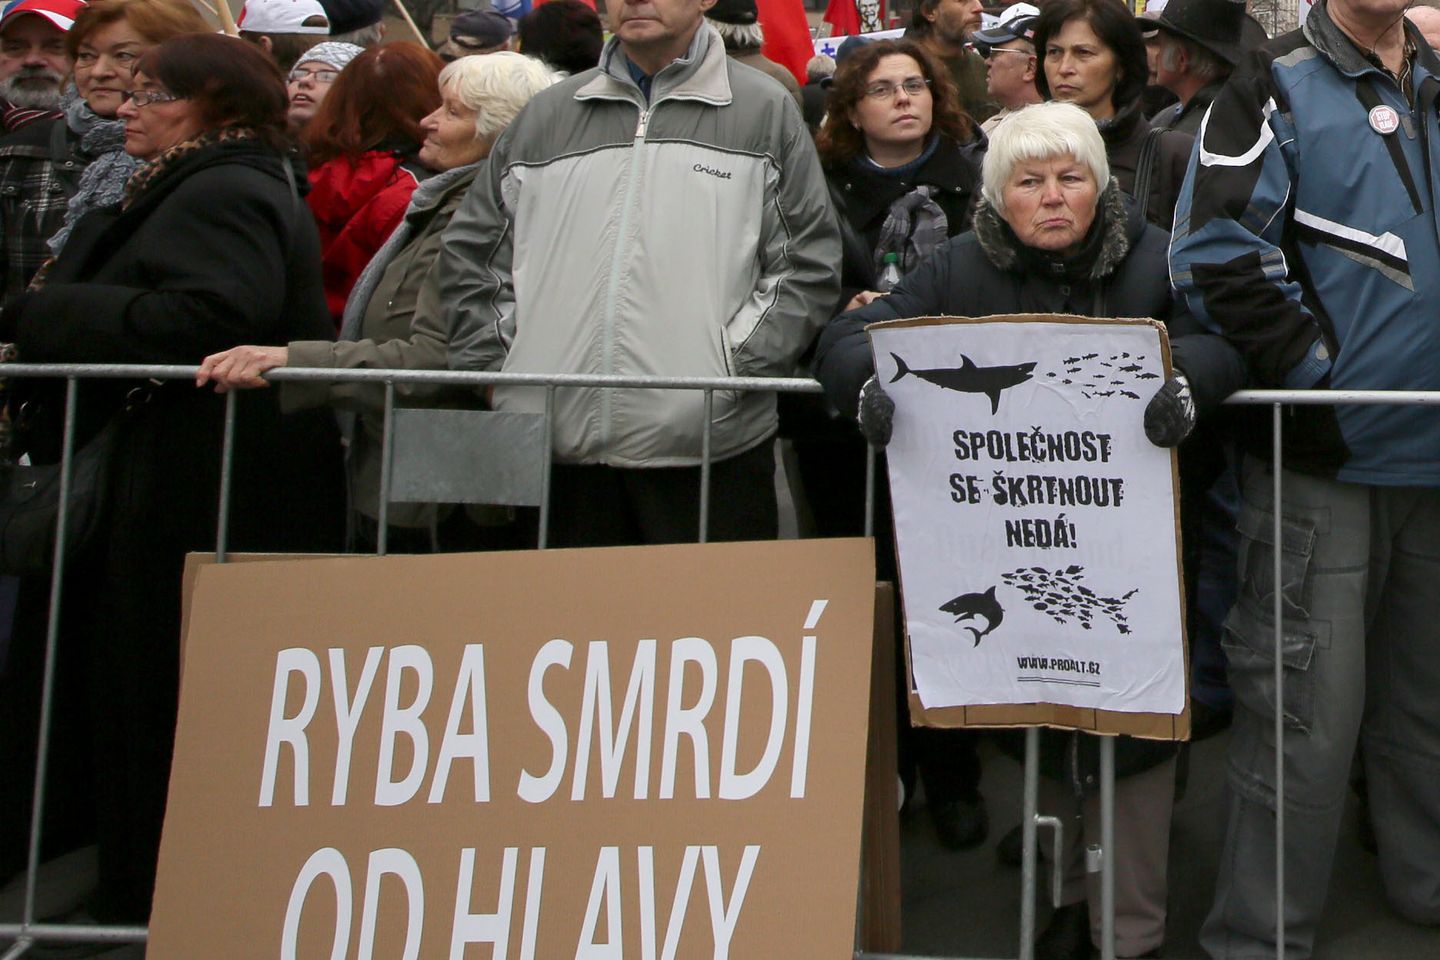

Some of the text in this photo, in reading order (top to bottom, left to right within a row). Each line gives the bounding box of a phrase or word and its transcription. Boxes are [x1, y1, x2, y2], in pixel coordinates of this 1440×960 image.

[693, 163, 732, 180] Cricket
[952, 426, 1112, 463] SPOLEČNOST
[949, 470, 1124, 508] SE ŠKRTNOUT
[1004, 513, 1078, 550] NEDÁ!
[258, 599, 829, 807] RYBA SMRDÍ
[280, 847, 425, 960] OD
